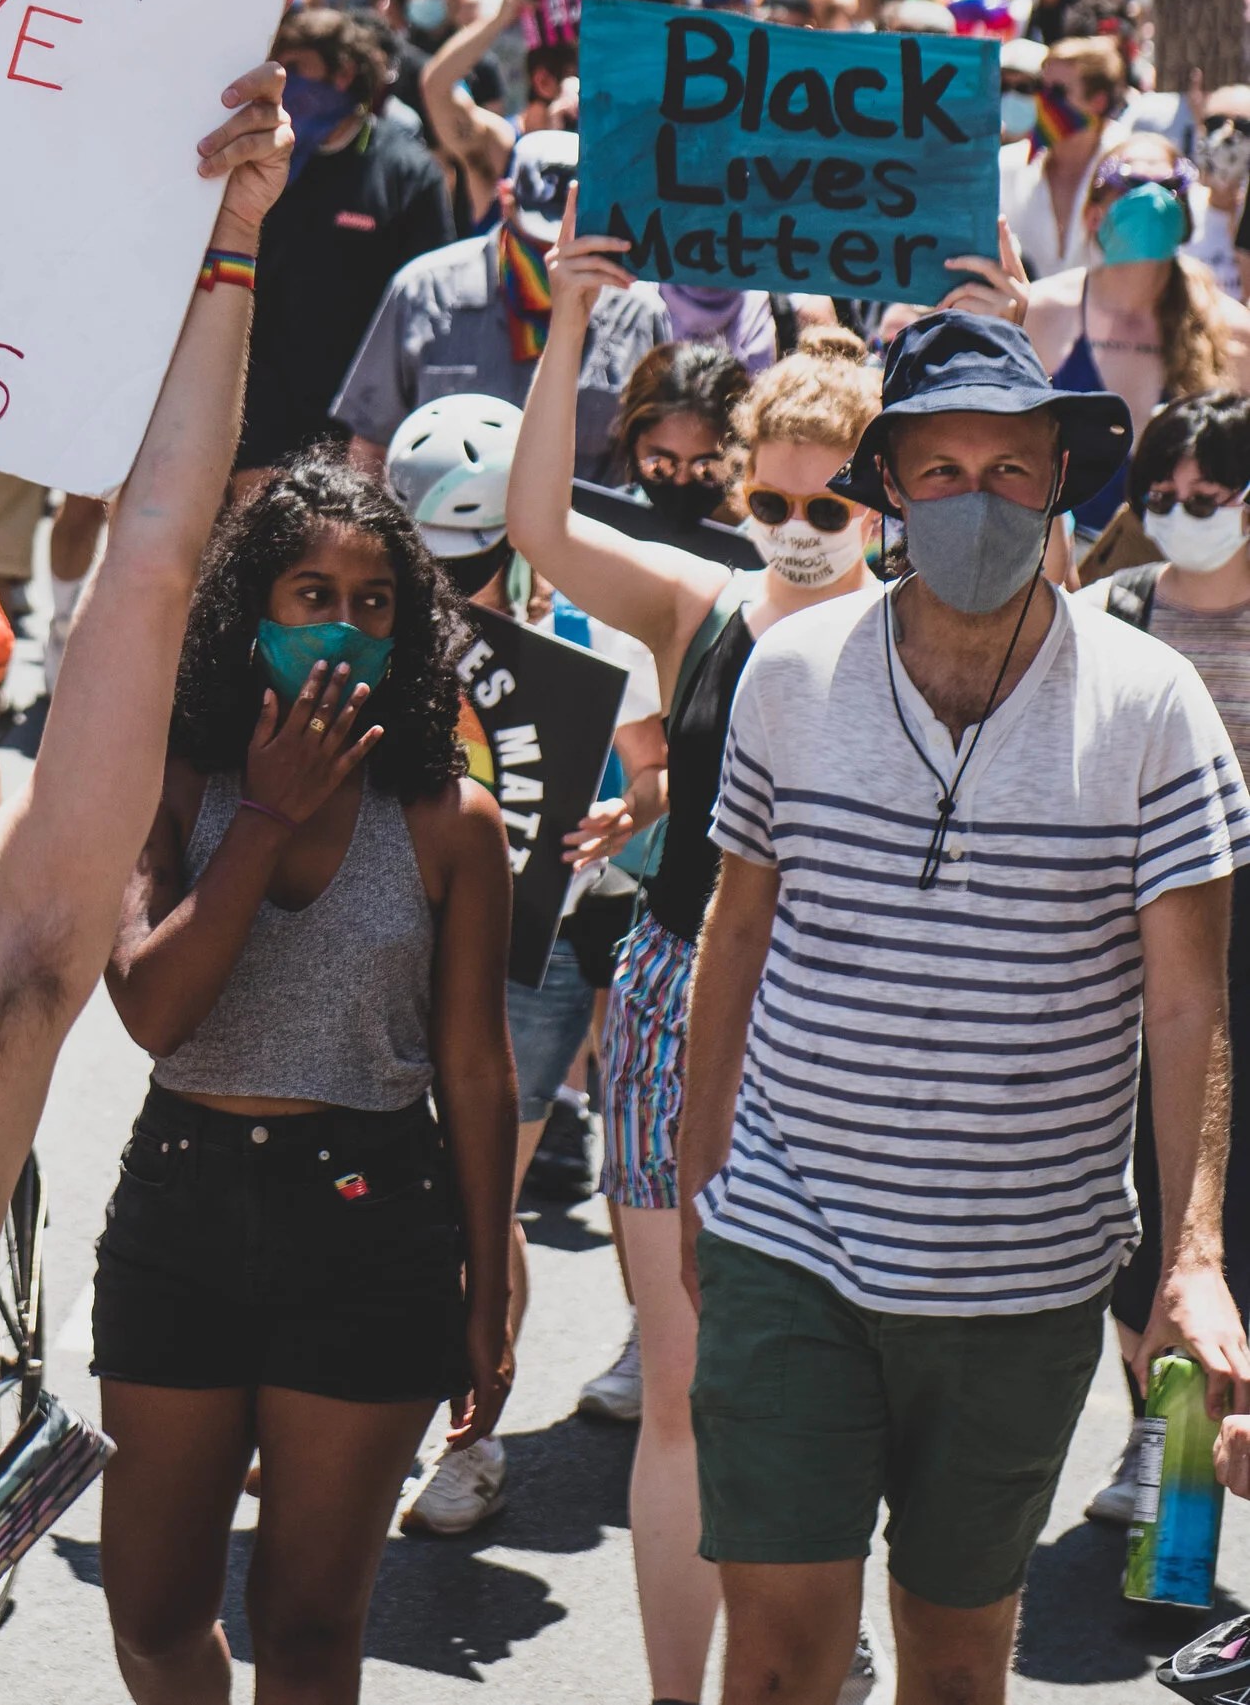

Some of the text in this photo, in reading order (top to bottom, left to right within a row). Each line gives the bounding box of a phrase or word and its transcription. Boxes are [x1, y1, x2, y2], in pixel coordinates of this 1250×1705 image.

[659, 16, 968, 144] Black
[655, 122, 918, 218] Lives
[607, 201, 938, 289] Matter
[790, 536, 823, 551] PRIDE
